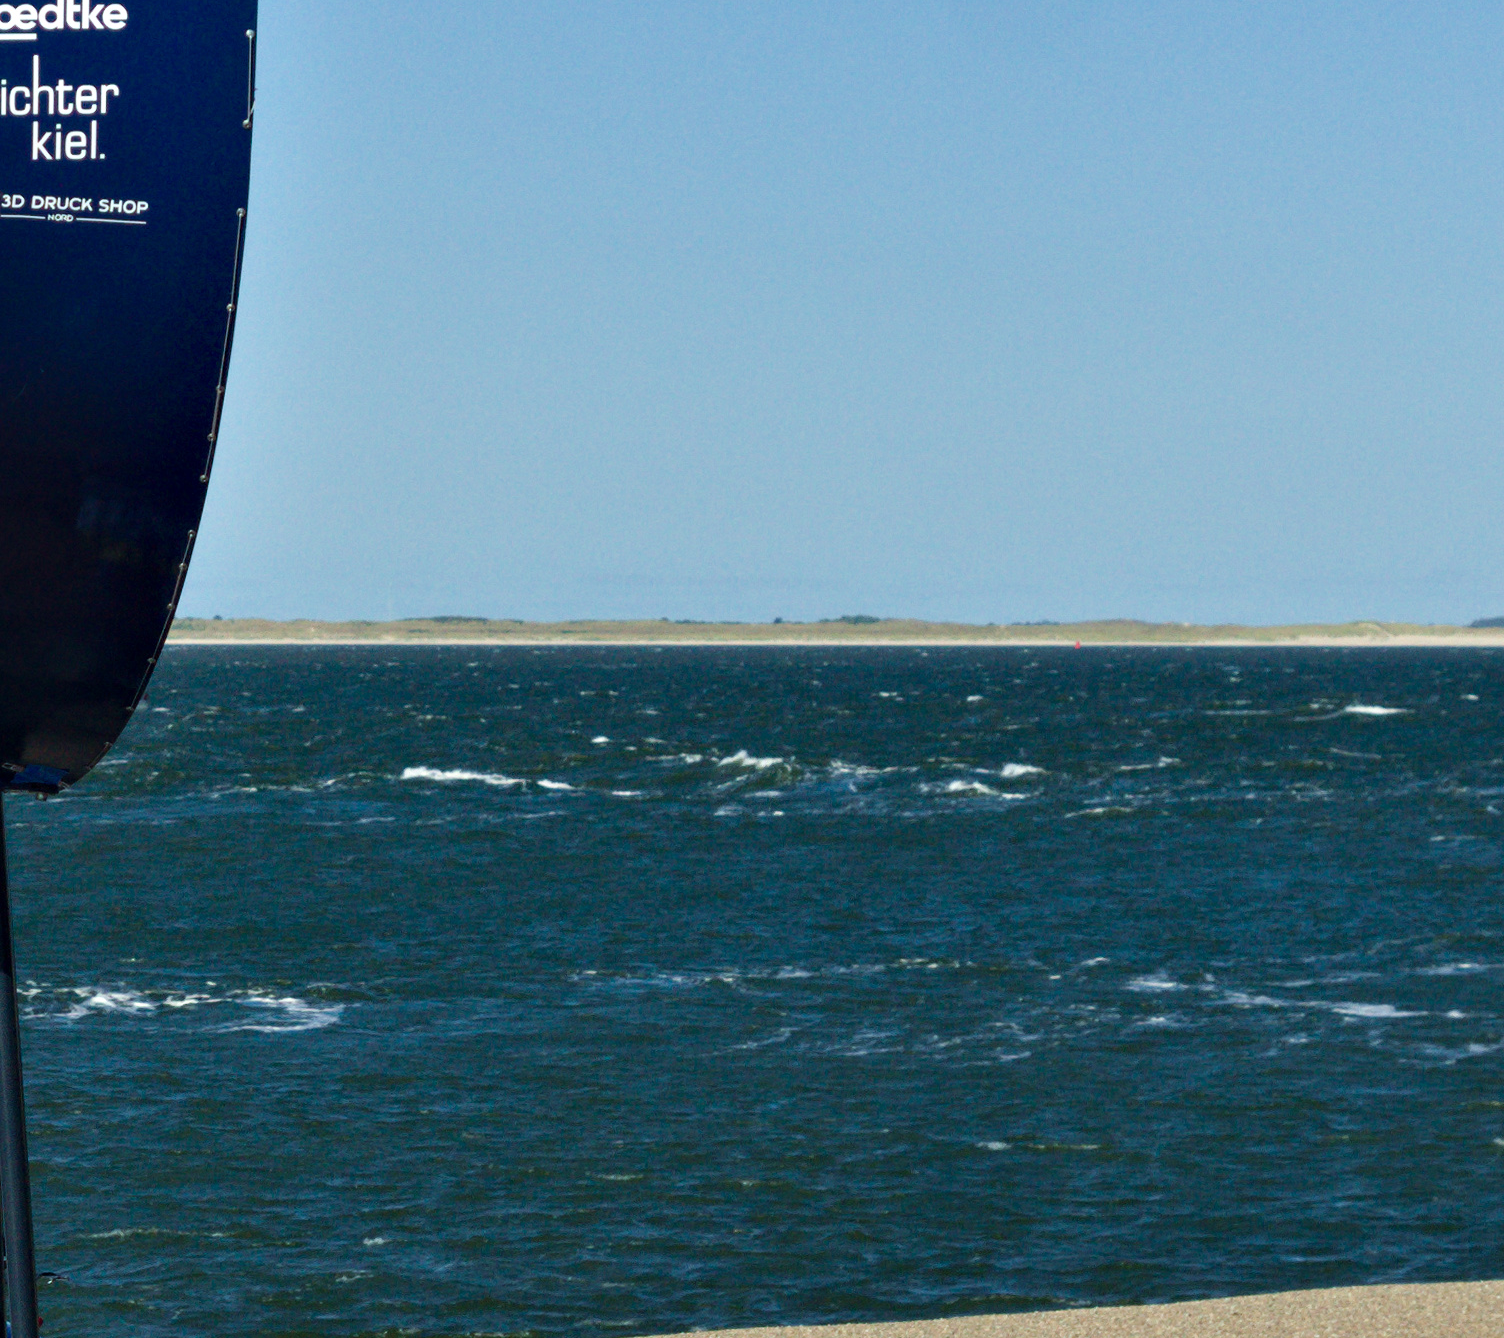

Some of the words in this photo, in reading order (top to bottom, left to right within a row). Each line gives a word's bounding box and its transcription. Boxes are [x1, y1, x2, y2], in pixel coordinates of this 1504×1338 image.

[31, 119, 106, 161] kiel.
[0, 193, 26, 209] 3D
[30, 195, 93, 212] DRUCK
[98, 198, 149, 215] SHOP
[47, 213, 74, 223] NORD
